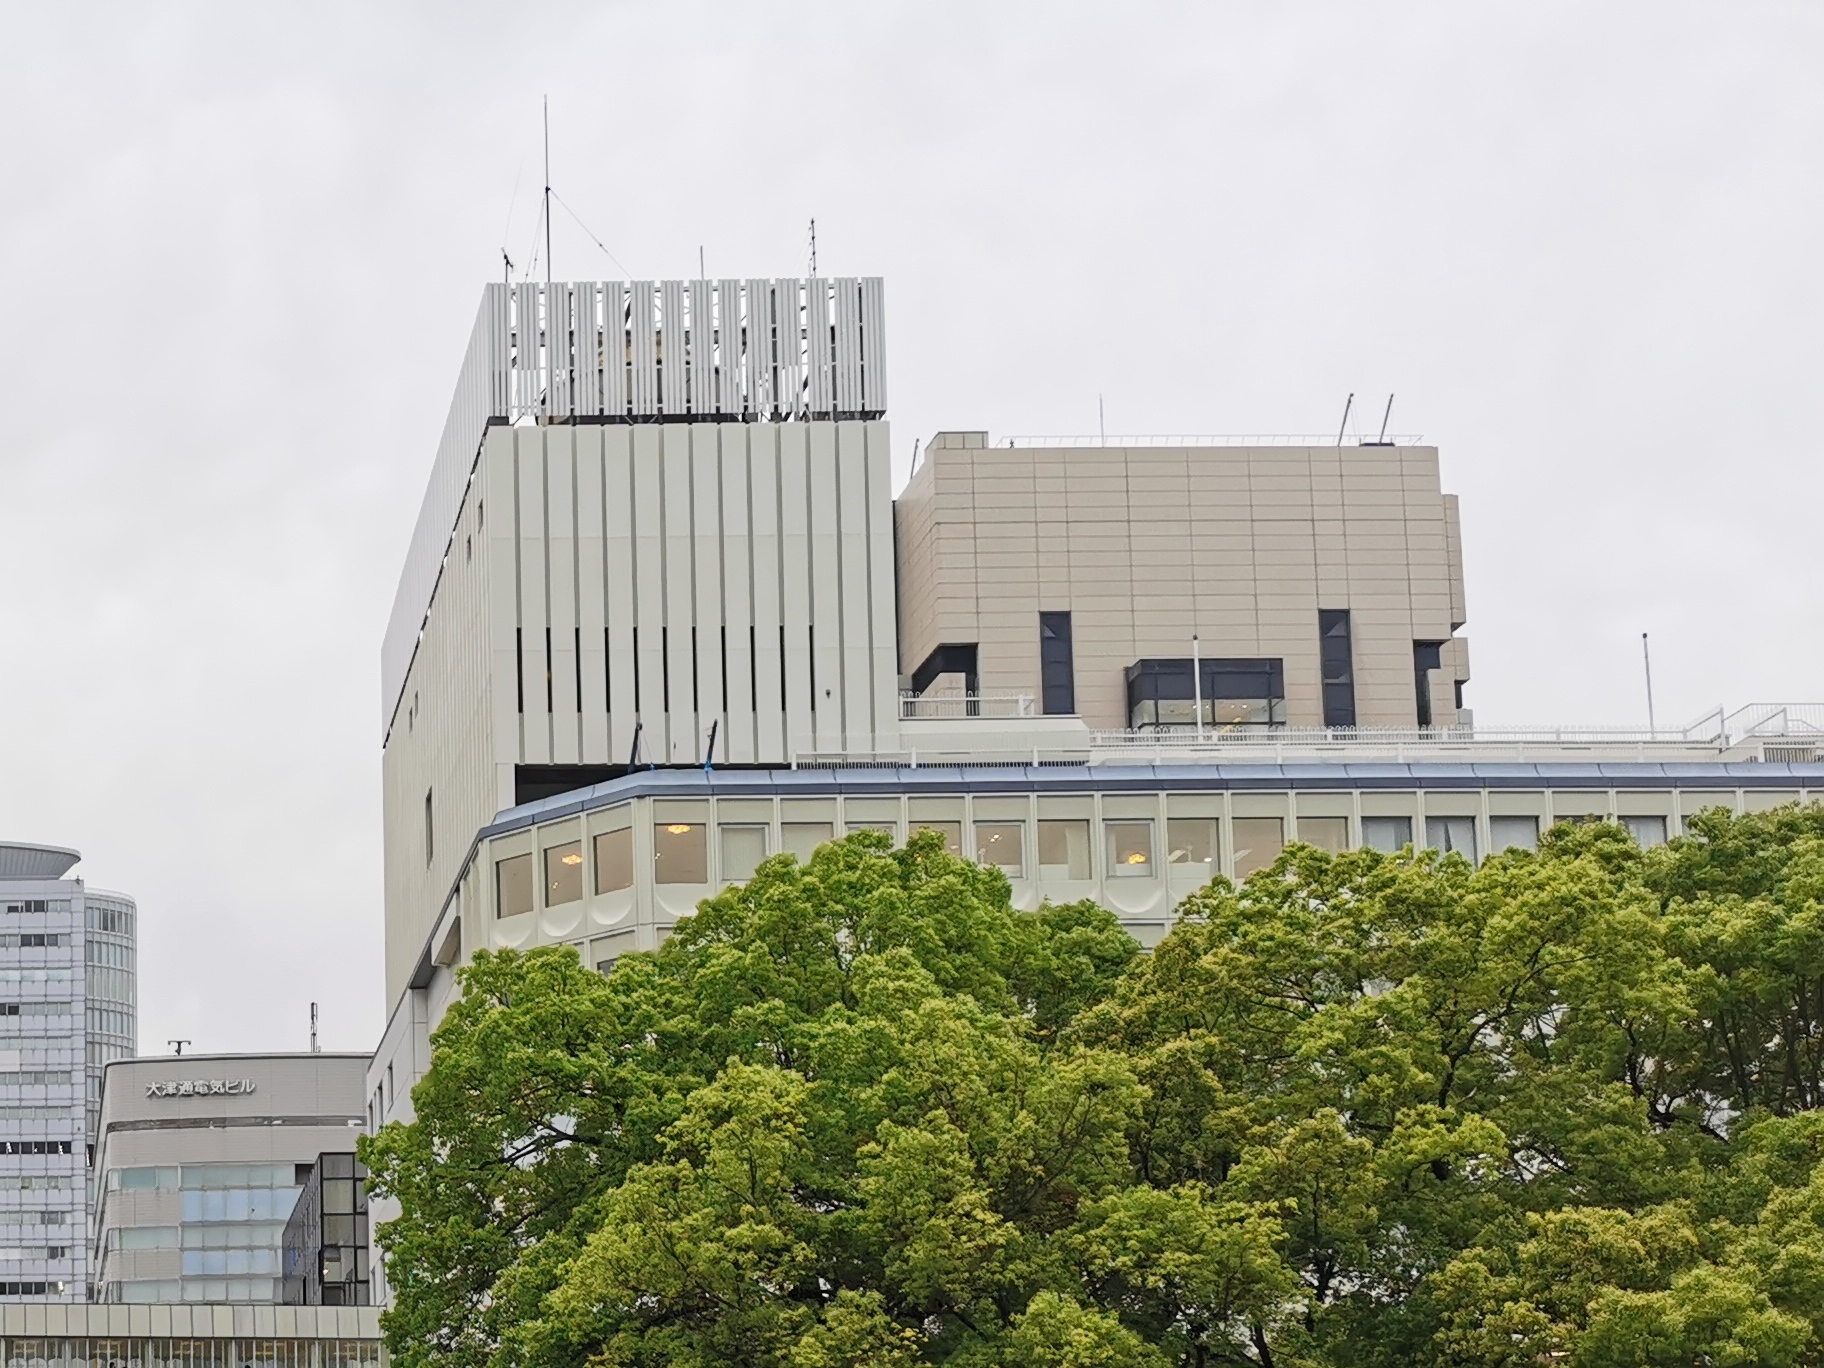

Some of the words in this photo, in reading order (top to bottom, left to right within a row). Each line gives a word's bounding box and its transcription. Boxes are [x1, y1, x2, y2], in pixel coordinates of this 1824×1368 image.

[145, 1078, 257, 1097] 大津通電気ビル
